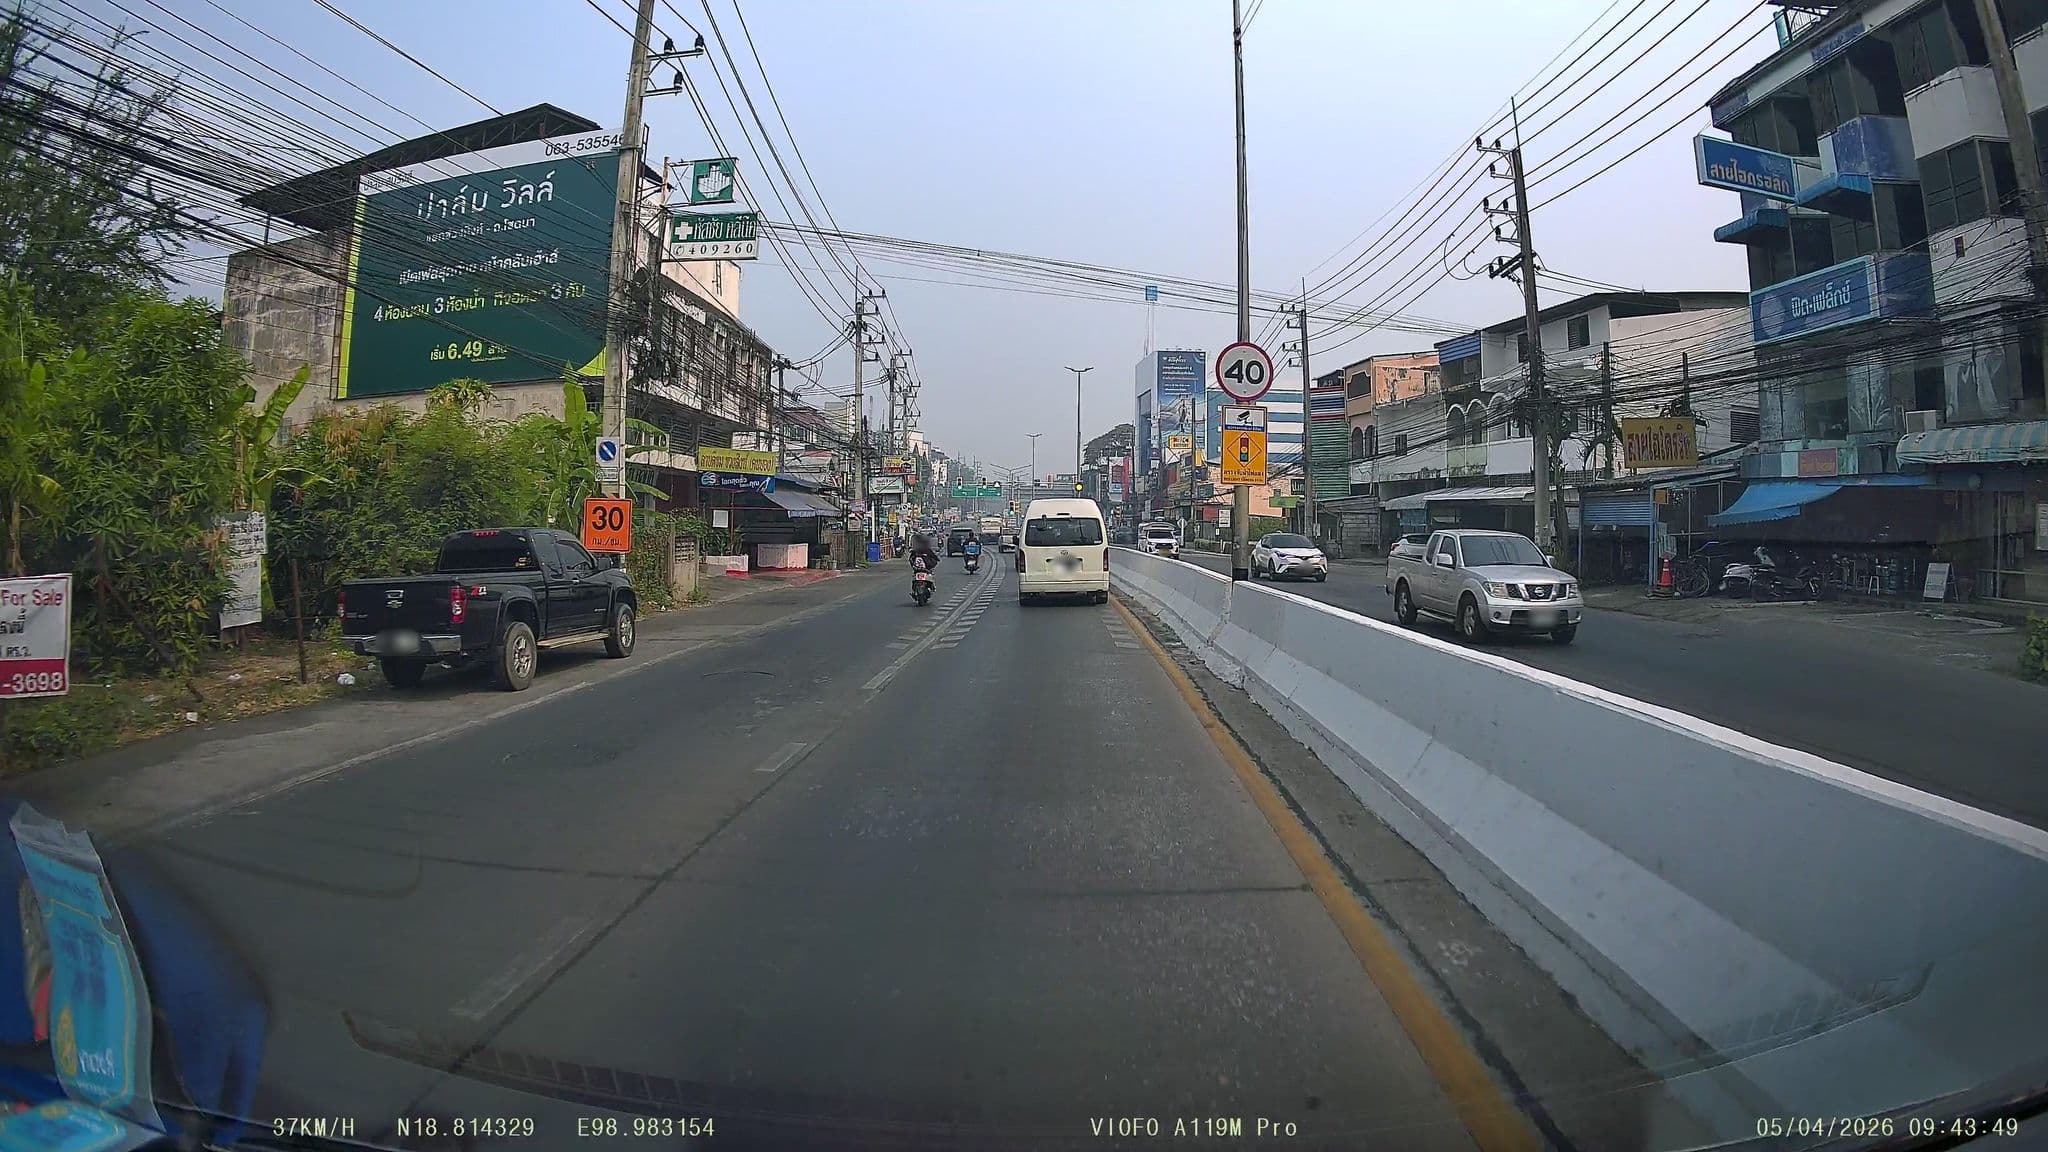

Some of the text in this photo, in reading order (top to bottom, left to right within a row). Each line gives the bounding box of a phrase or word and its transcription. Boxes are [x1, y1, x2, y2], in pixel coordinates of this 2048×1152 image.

[500, 170, 555, 208] วิลล์
[374, 305, 383, 321] 4
[434, 297, 444, 314] 3
[446, 288, 485, 313] ห้องน้ำ
[431, 344, 445, 360] เริ่ม
[447, 341, 483, 360] 6.49
[1224, 359, 1265, 385] 40
[592, 506, 623, 531] 30
[1, 588, 63, 606] For Sale
